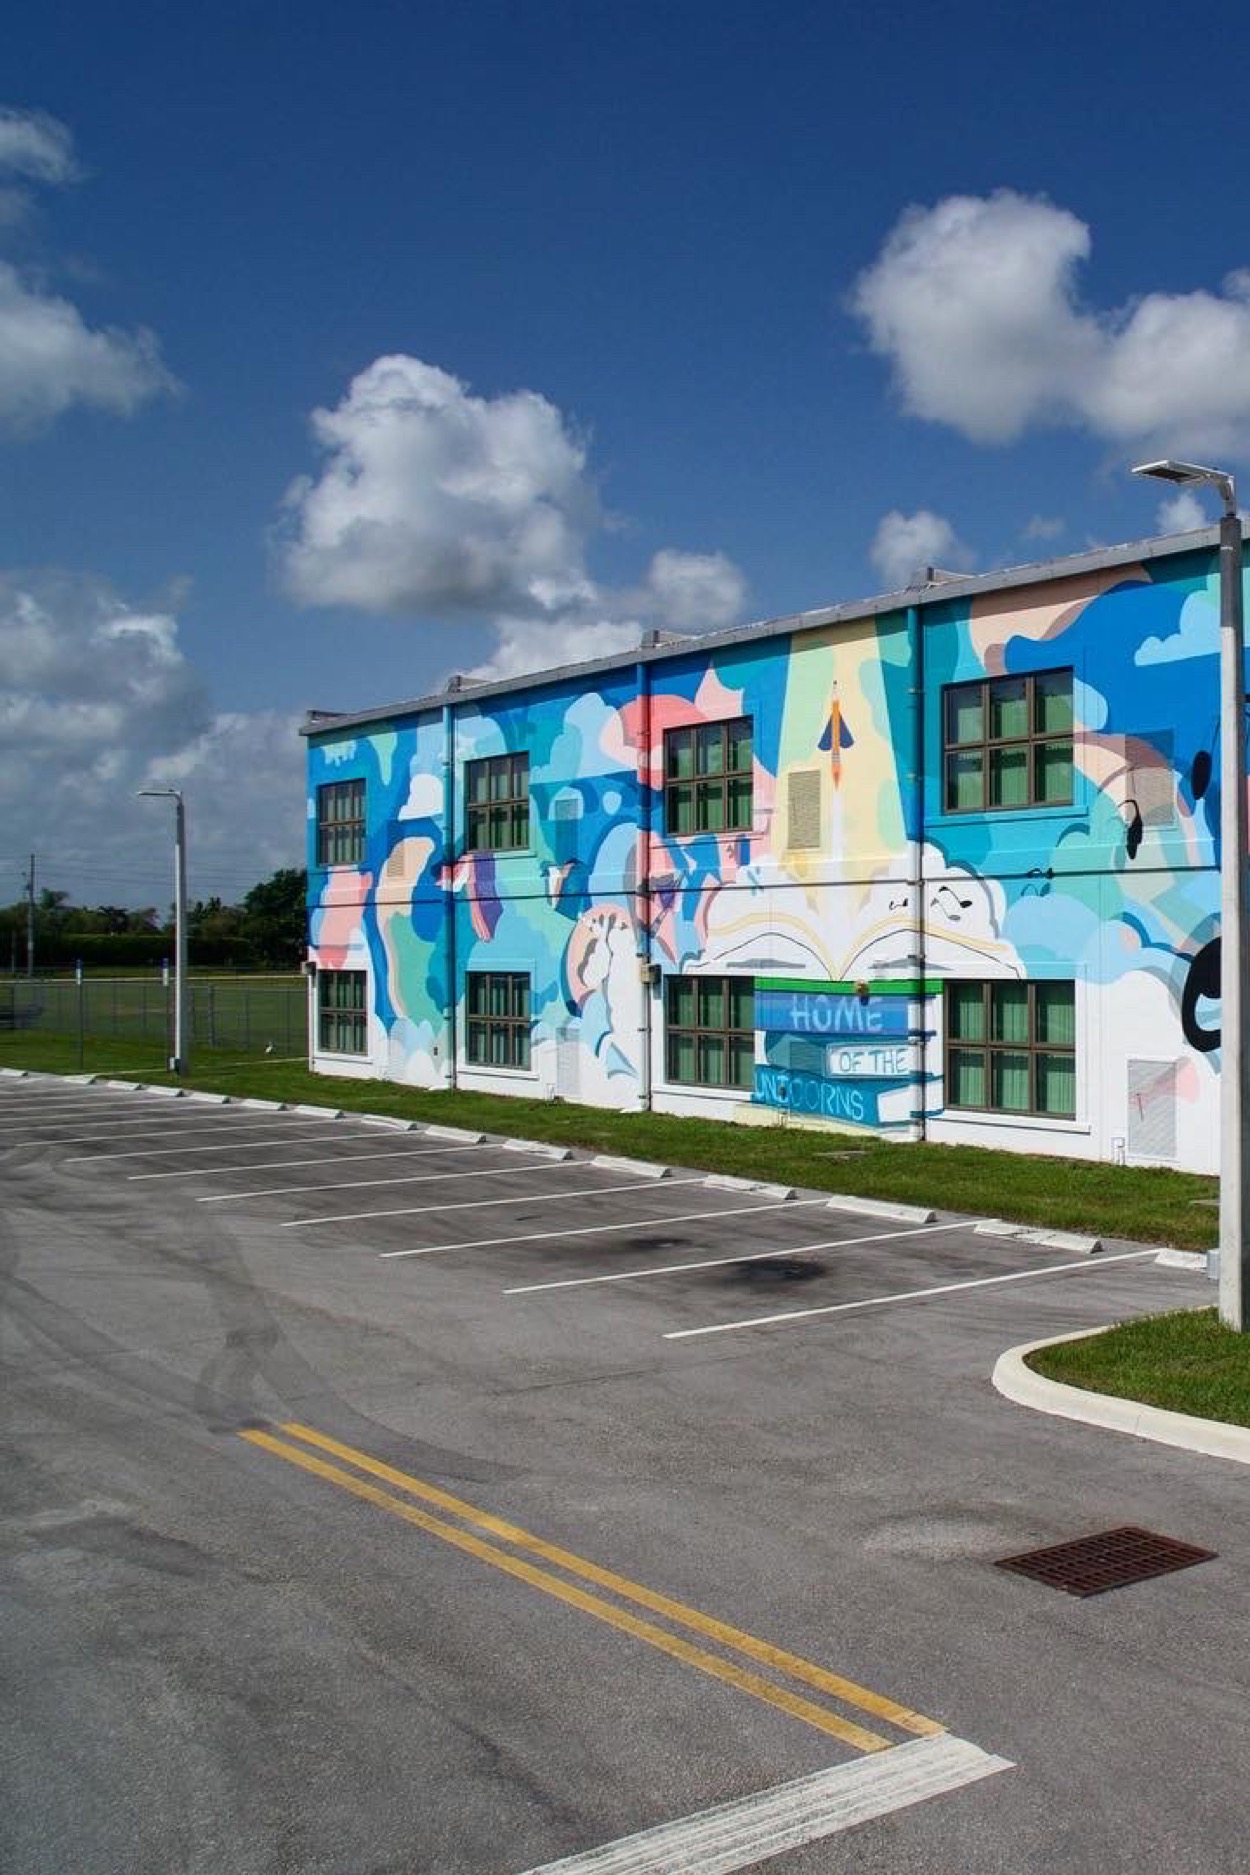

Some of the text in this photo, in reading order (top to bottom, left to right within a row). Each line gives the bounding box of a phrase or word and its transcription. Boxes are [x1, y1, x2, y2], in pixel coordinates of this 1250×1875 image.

[791, 994, 883, 1031] HOME
[839, 1048, 911, 1073] OF THE
[754, 1071, 864, 1121] UNICORNS
